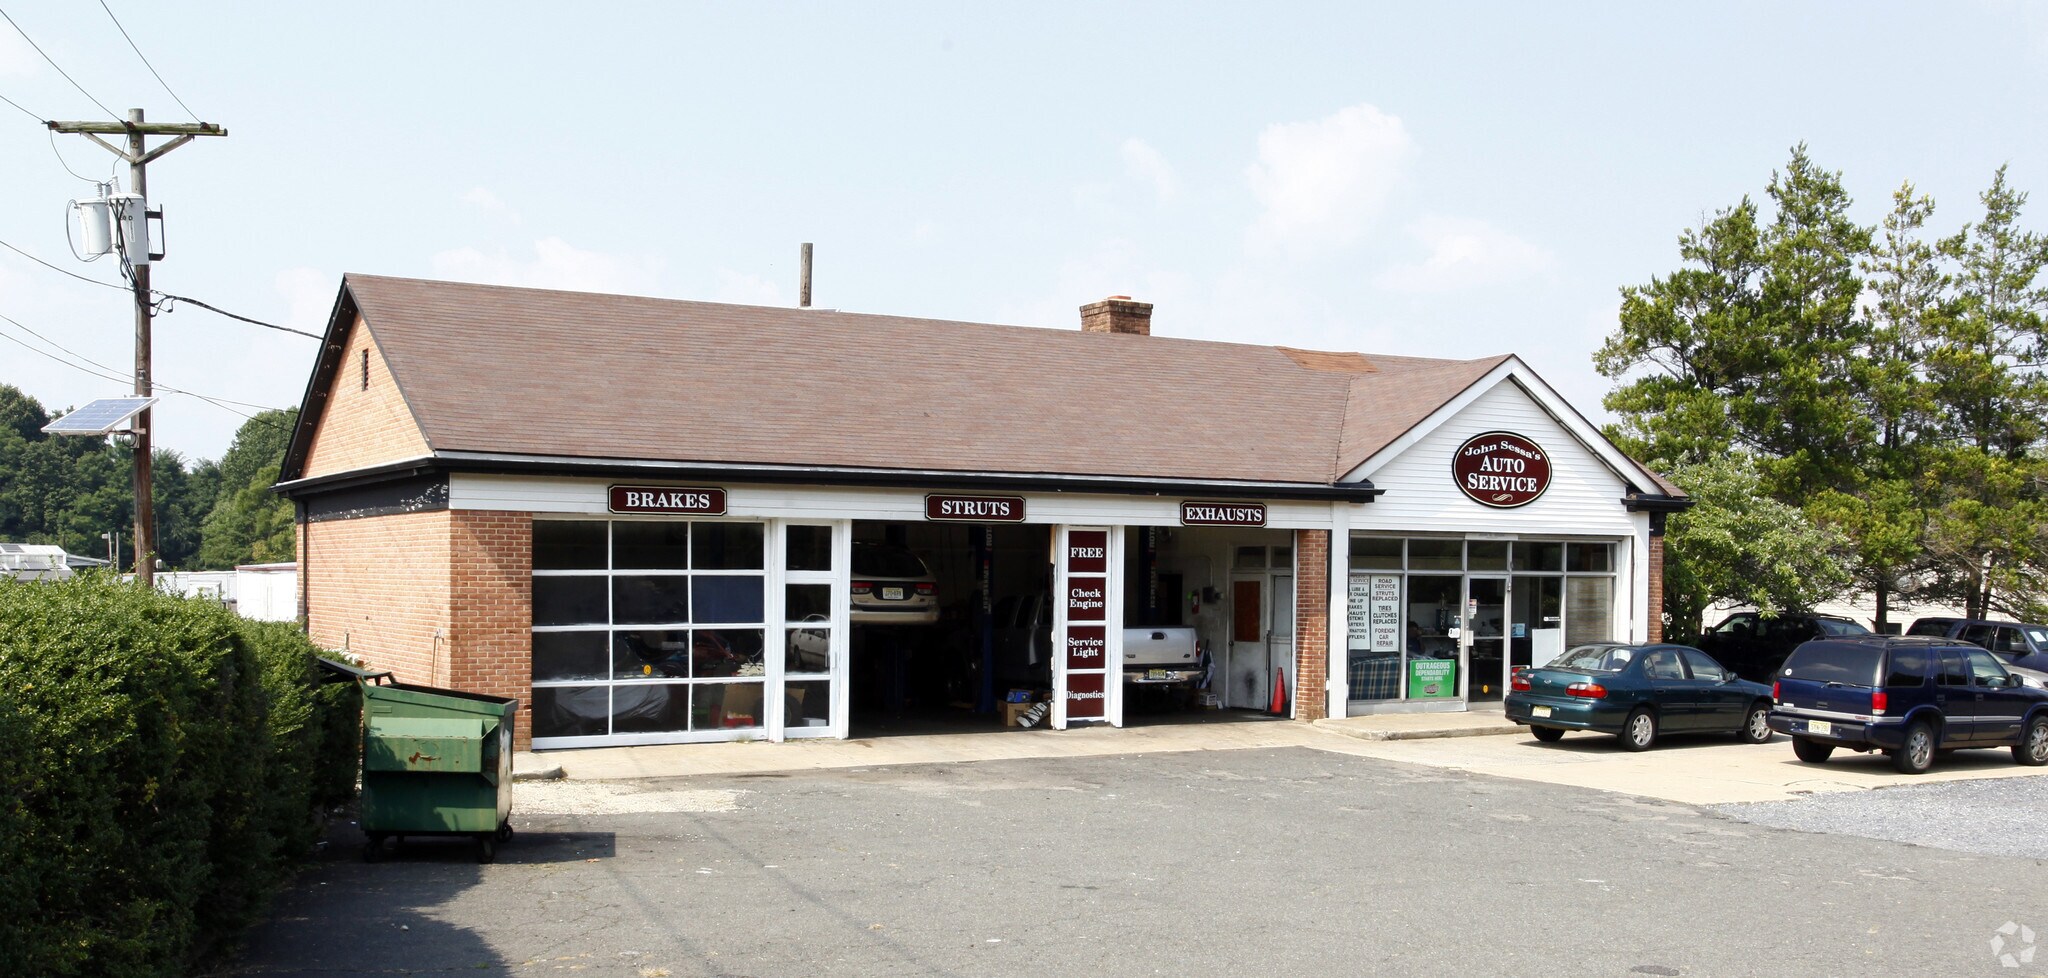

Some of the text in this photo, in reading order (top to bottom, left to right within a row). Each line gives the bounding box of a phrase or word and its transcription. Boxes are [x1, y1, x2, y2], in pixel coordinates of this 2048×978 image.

[1464, 440, 1541, 461] John Sessa's
[1480, 455, 1525, 474] AUTO
[1467, 472, 1537, 492] SERVICE
[626, 491, 710, 509] BRAKES
[941, 500, 1010, 516] STRUTS
[1185, 506, 1262, 522] EXHAUSTS
[1070, 547, 1103, 558] FREE
[1071, 588, 1101, 598] Check
[1069, 599, 1103, 610] Engine
[1068, 637, 1104, 647] Service
[1072, 647, 1099, 659] Light
[1415, 662, 1450, 670] OUTRAGEOUS
[1066, 690, 1105, 701] Diagnostics
